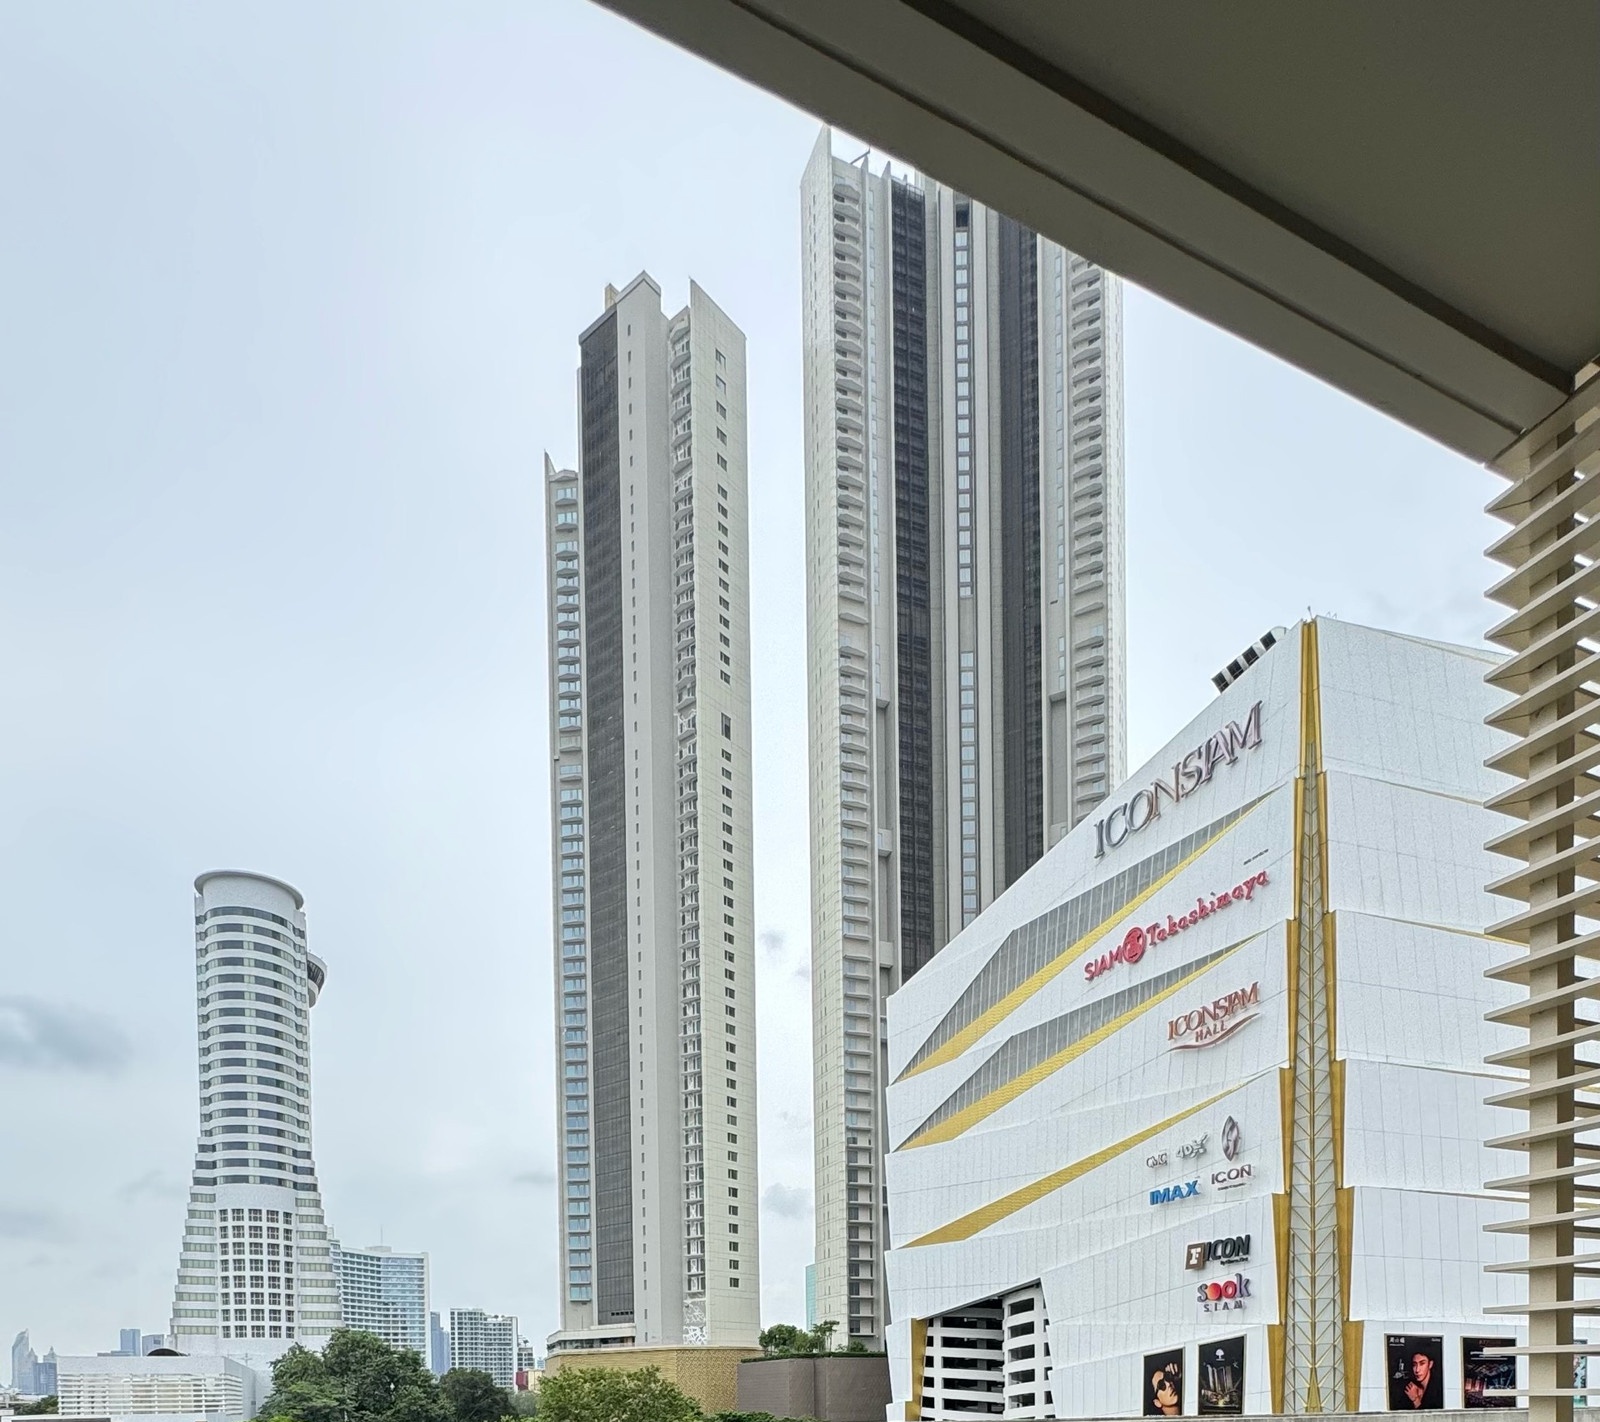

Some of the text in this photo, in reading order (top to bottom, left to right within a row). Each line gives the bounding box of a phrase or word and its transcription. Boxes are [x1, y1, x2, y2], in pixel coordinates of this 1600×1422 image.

[1093, 700, 1263, 859] ICONSIAM
[1084, 870, 1269, 981] SIAM Takashimaya
[1168, 981, 1259, 1041] ICONSIAM
[1195, 1020, 1227, 1042] HALL
[1149, 1180, 1200, 1206] IMAX
[1211, 1164, 1252, 1185] ICON
